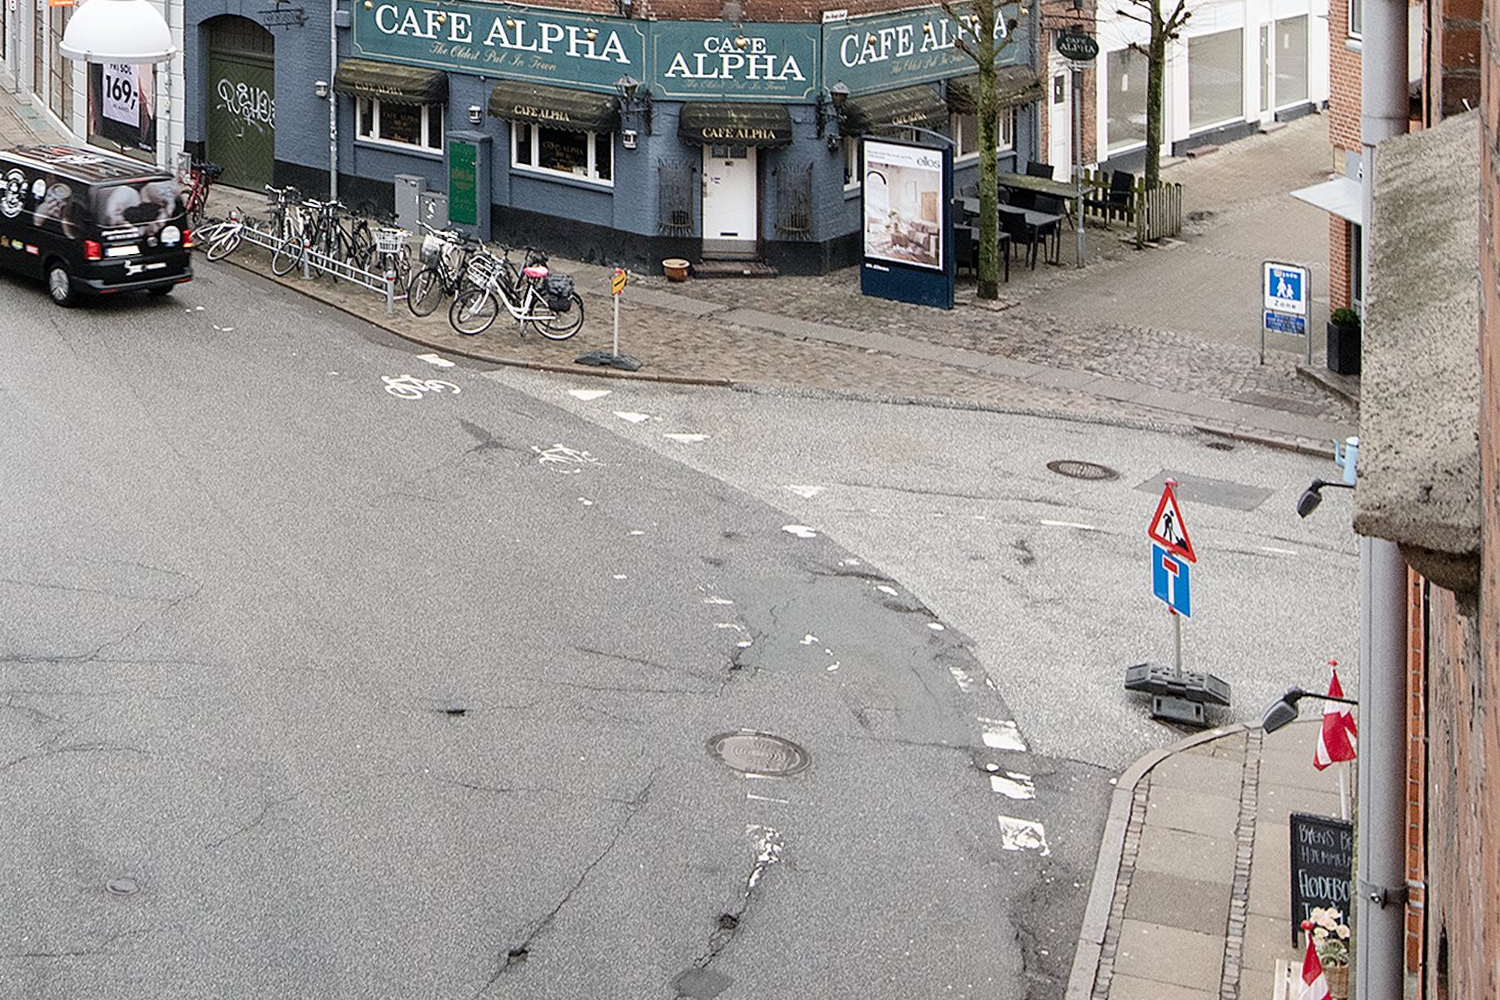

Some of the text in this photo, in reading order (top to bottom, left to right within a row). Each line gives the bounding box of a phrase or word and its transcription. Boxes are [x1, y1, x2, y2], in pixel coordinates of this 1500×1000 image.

[374, 4, 632, 65] CAFE ALPHA
[429, 41, 450, 55] The
[840, 23, 914, 68] CAFE
[664, 52, 807, 81] ALPHA
[514, 105, 570, 122] CAFE ALPHA
[702, 127, 777, 140] CAFE ALPHA
[916, 155, 941, 169] ellos
[1299, 824, 1335, 847] BYENS
